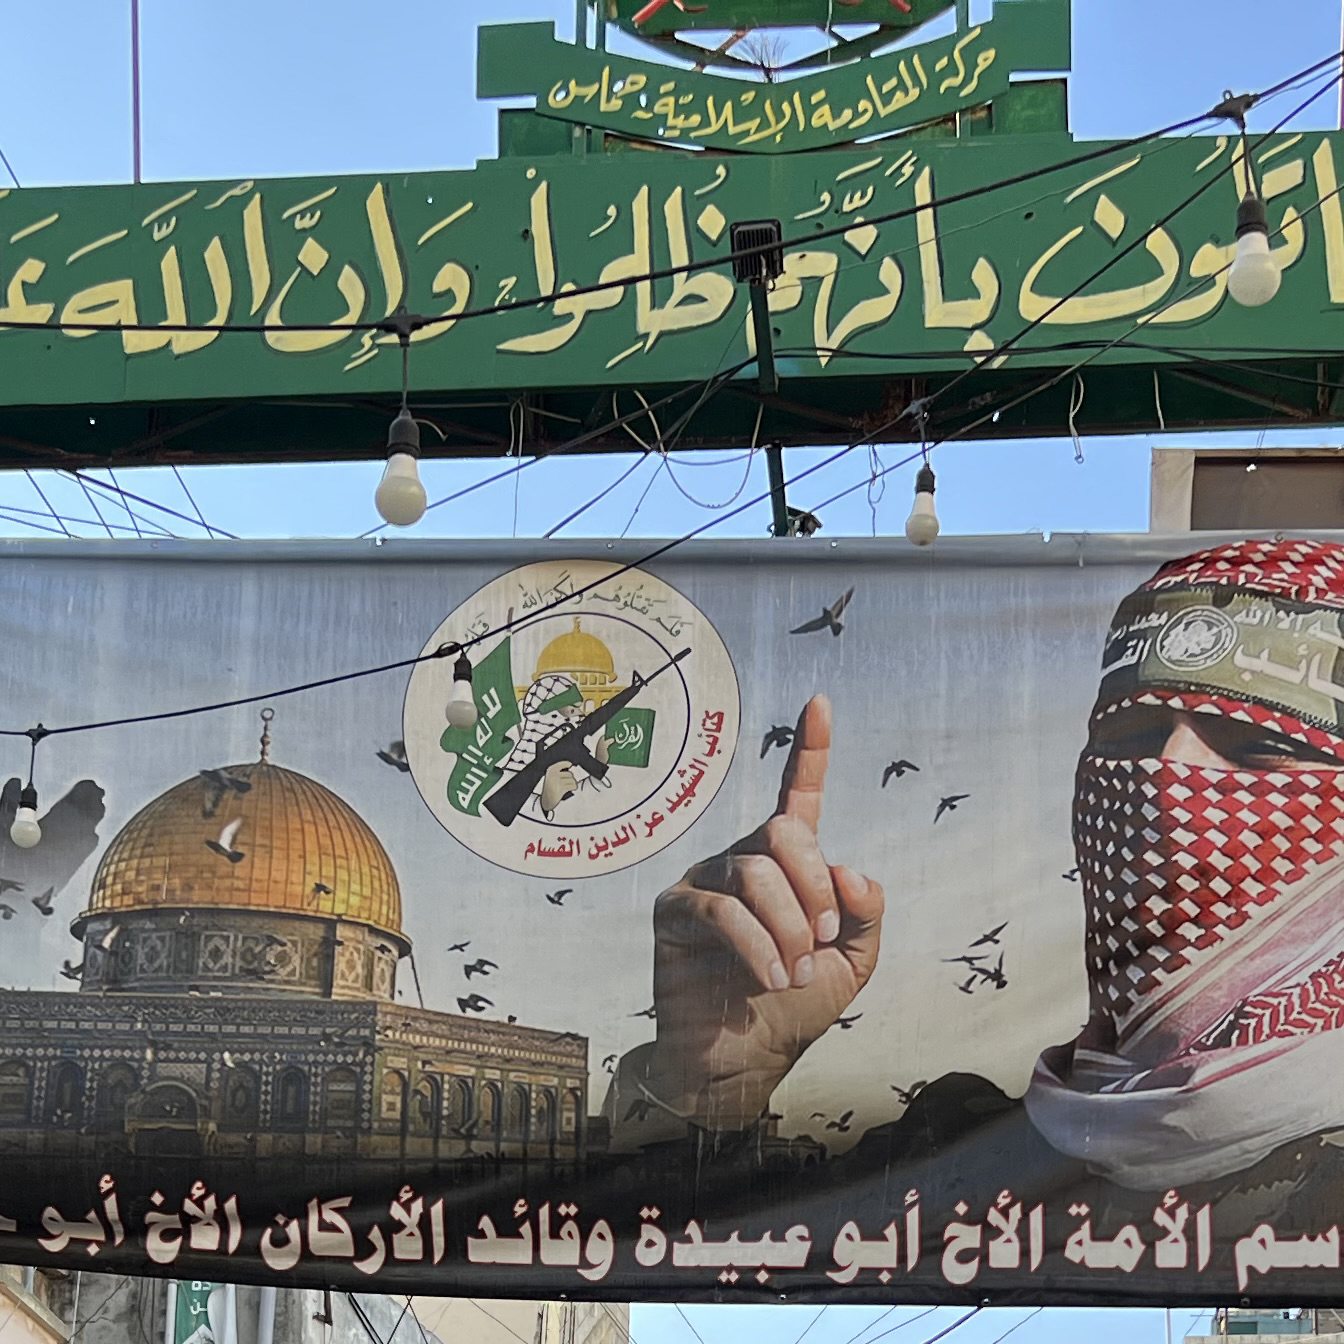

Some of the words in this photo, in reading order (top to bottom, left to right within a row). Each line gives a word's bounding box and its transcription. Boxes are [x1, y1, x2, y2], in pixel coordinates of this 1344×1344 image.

[697, 709, 725, 758] كتائب
[636, 811, 665, 838] عز
[665, 757, 709, 814] الشهيد
[524, 836, 581, 861] القسام
[587, 822, 637, 861] الدين
[37, 1172, 125, 1256] أبو
[143, 1180, 242, 1266] الأخ
[259, 1185, 446, 1275] الأركان
[466, 1200, 615, 1282] وقائد
[633, 1204, 813, 1284] عبيدة
[828, 1187, 921, 1286] أبو
[940, 1187, 1046, 1286] الأخ
[1062, 1188, 1214, 1270] الأمة
